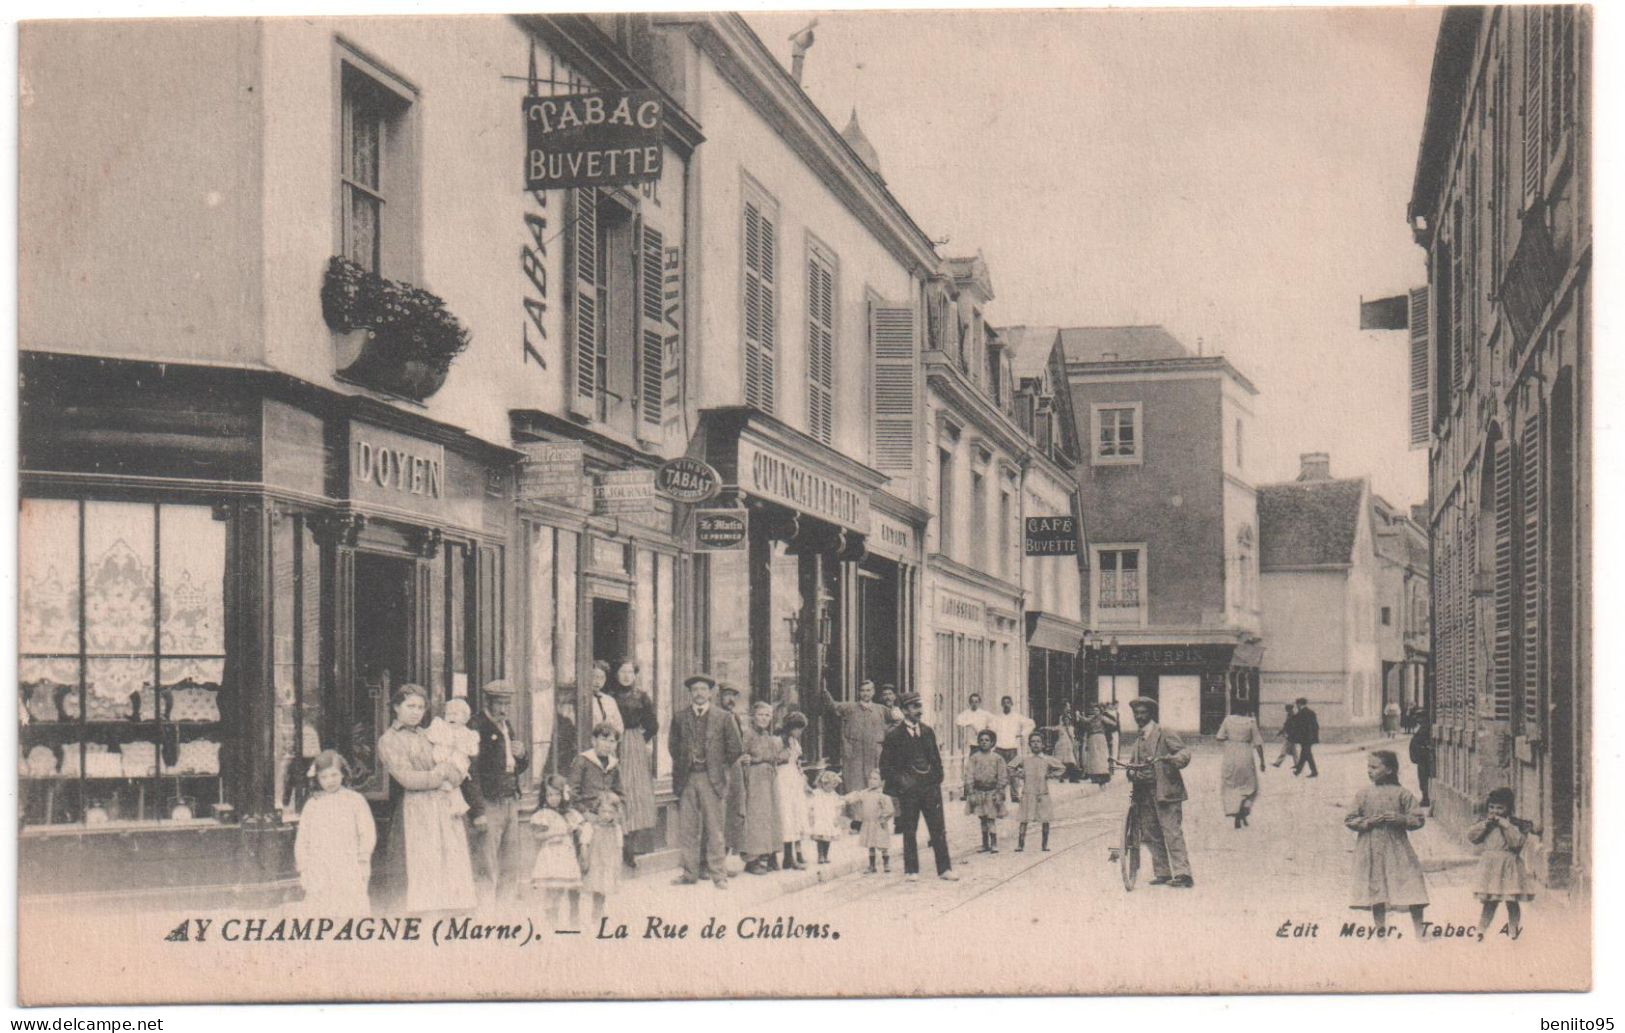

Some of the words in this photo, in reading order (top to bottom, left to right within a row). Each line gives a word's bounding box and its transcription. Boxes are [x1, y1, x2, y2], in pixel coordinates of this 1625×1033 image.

[529, 97, 660, 134] TABAC
[528, 147, 660, 181] BUVETTE
[357, 440, 444, 500] DOYEN
[1026, 538, 1077, 552] BUVETTE
